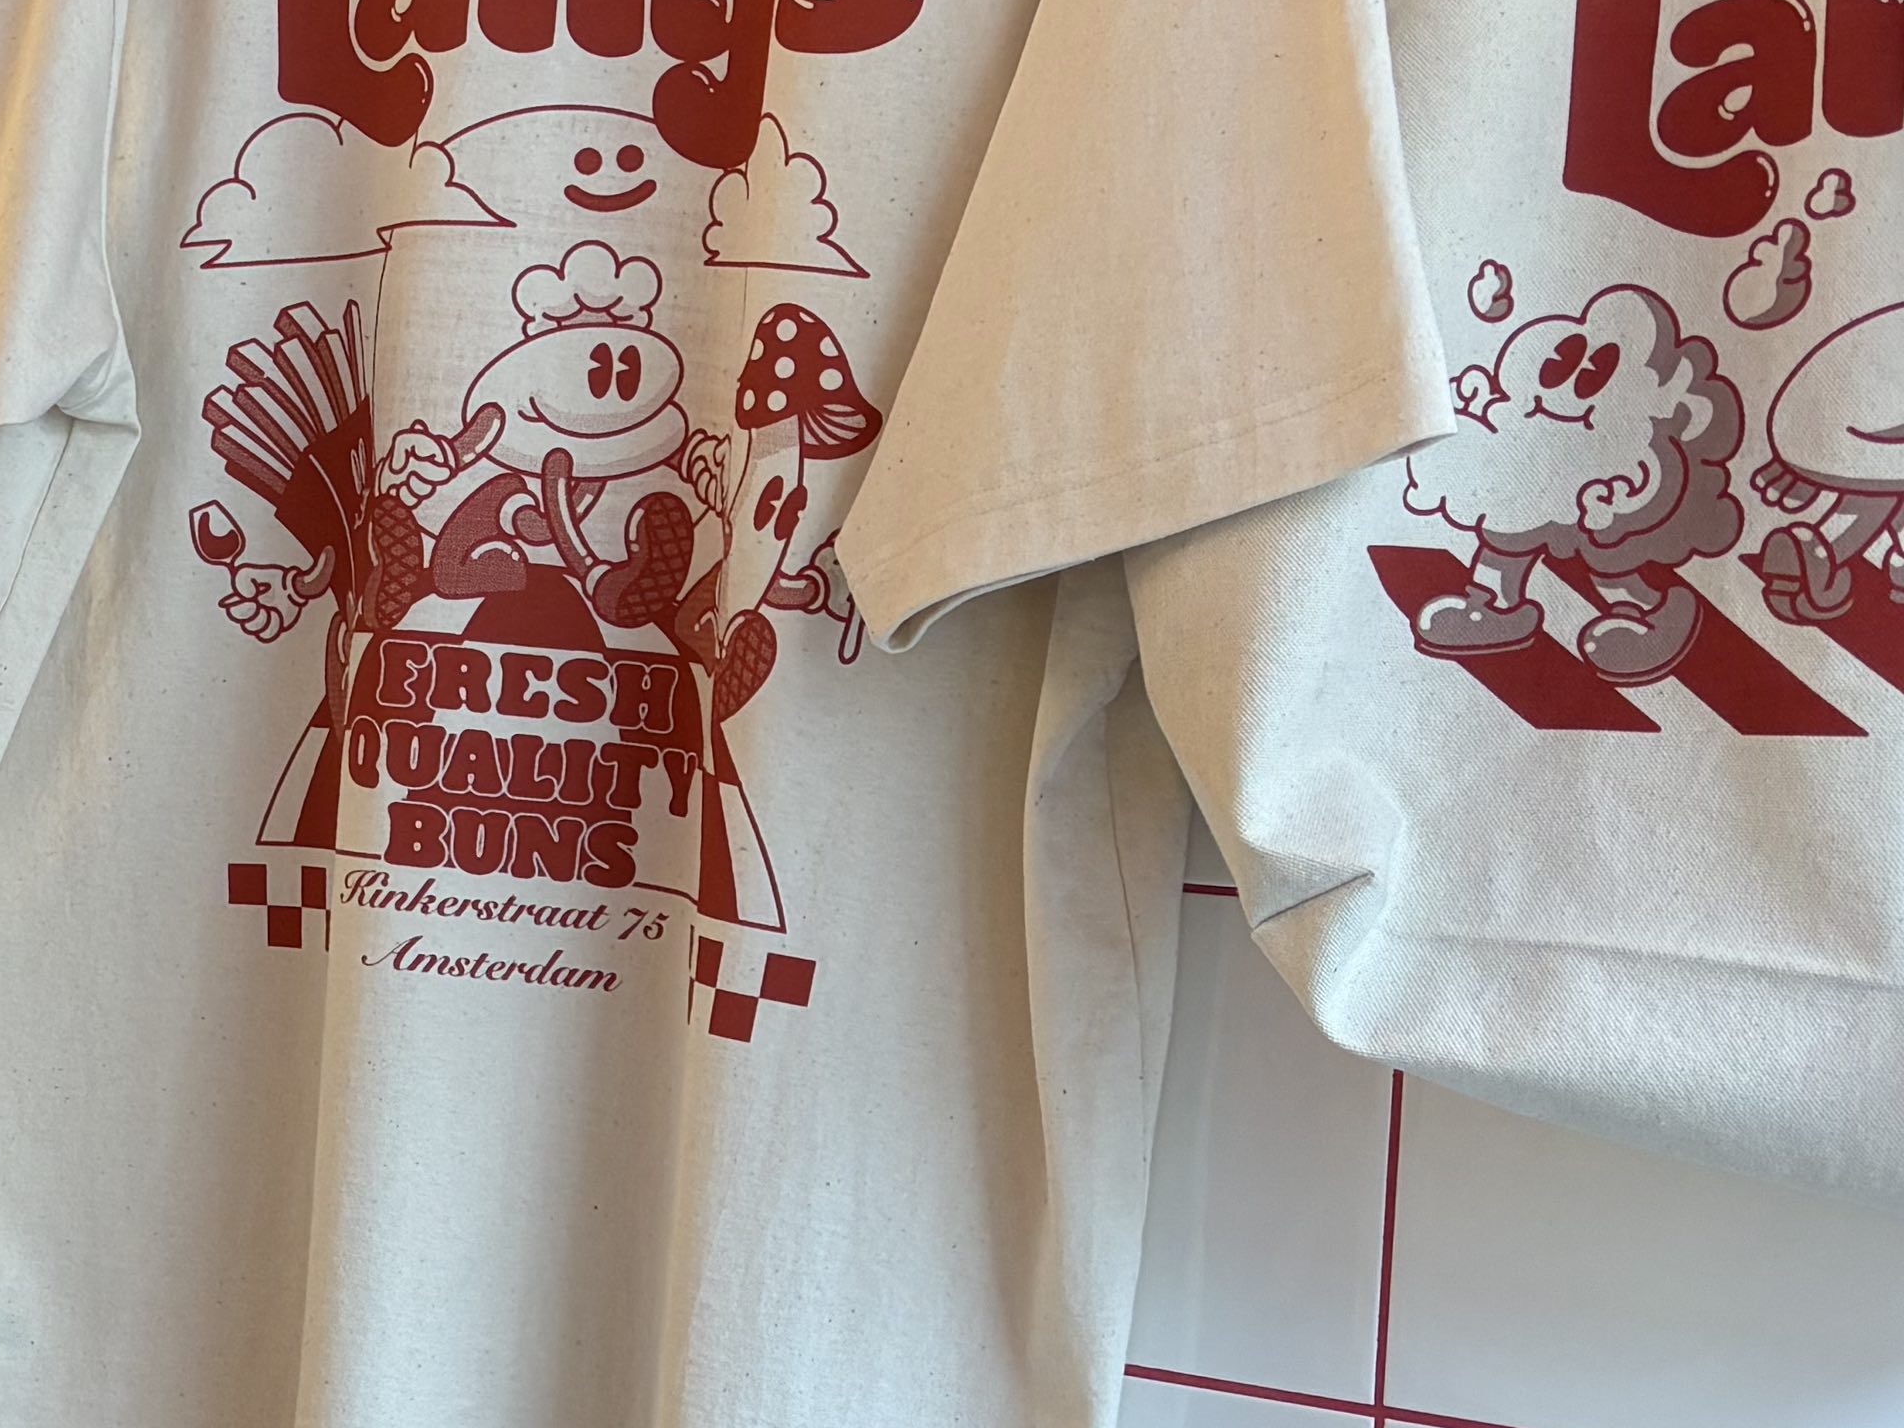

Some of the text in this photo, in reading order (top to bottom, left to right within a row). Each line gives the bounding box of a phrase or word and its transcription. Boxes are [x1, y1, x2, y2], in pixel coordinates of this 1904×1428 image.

[376, 639, 679, 734] FRESH
[347, 714, 699, 819] QUALITY
[382, 800, 641, 890] BUNS
[339, 868, 670, 942] Kinkerstraat 75
[360, 934, 623, 993] Amsterdam
